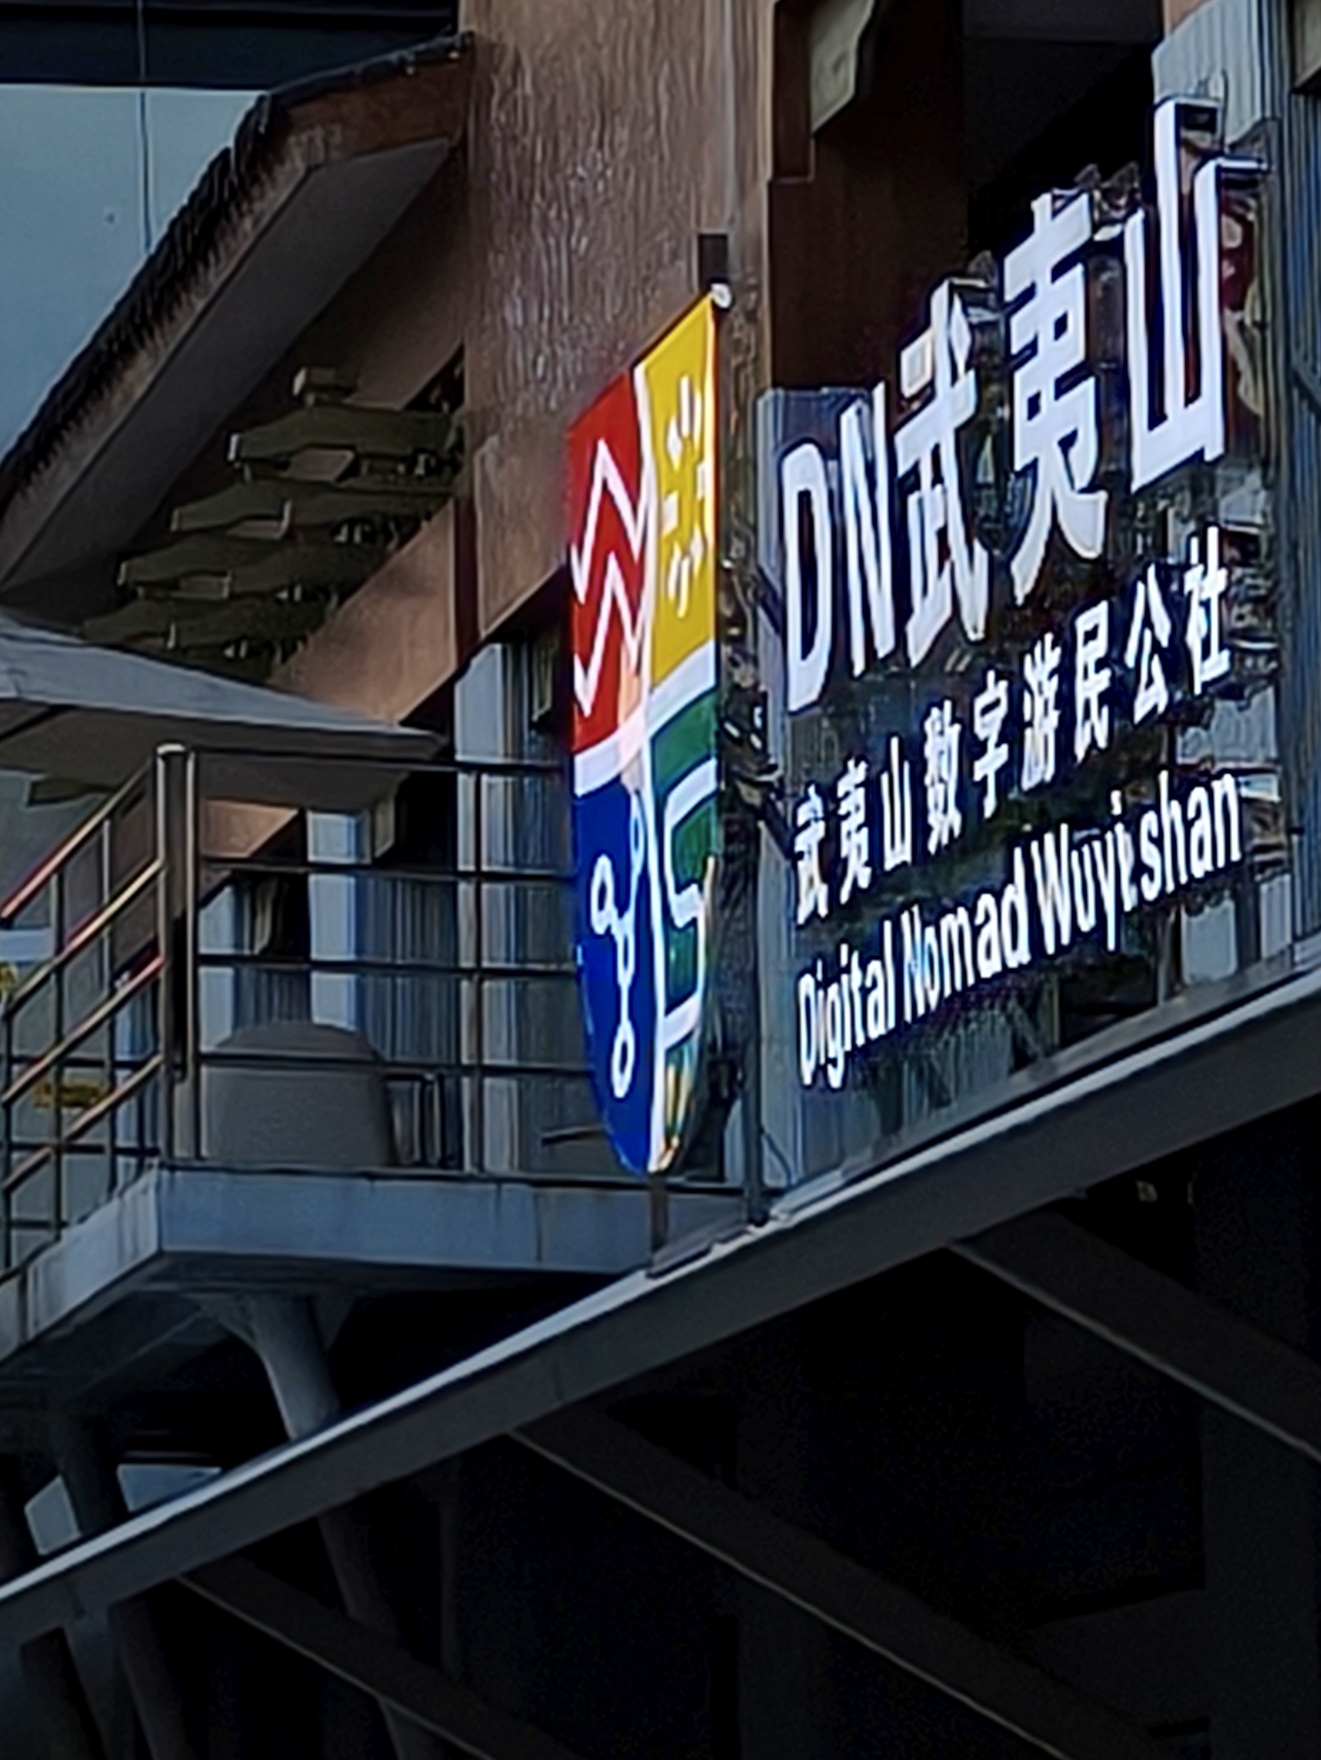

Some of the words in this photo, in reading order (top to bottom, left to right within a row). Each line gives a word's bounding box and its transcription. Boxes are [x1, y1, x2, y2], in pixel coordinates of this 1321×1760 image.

[782, 99, 1225, 712] DN武夷山
[794, 526, 1231, 925] 武夷山数字游民公社
[798, 921, 896, 1089] Digital
[902, 846, 1031, 1024] Nomad
